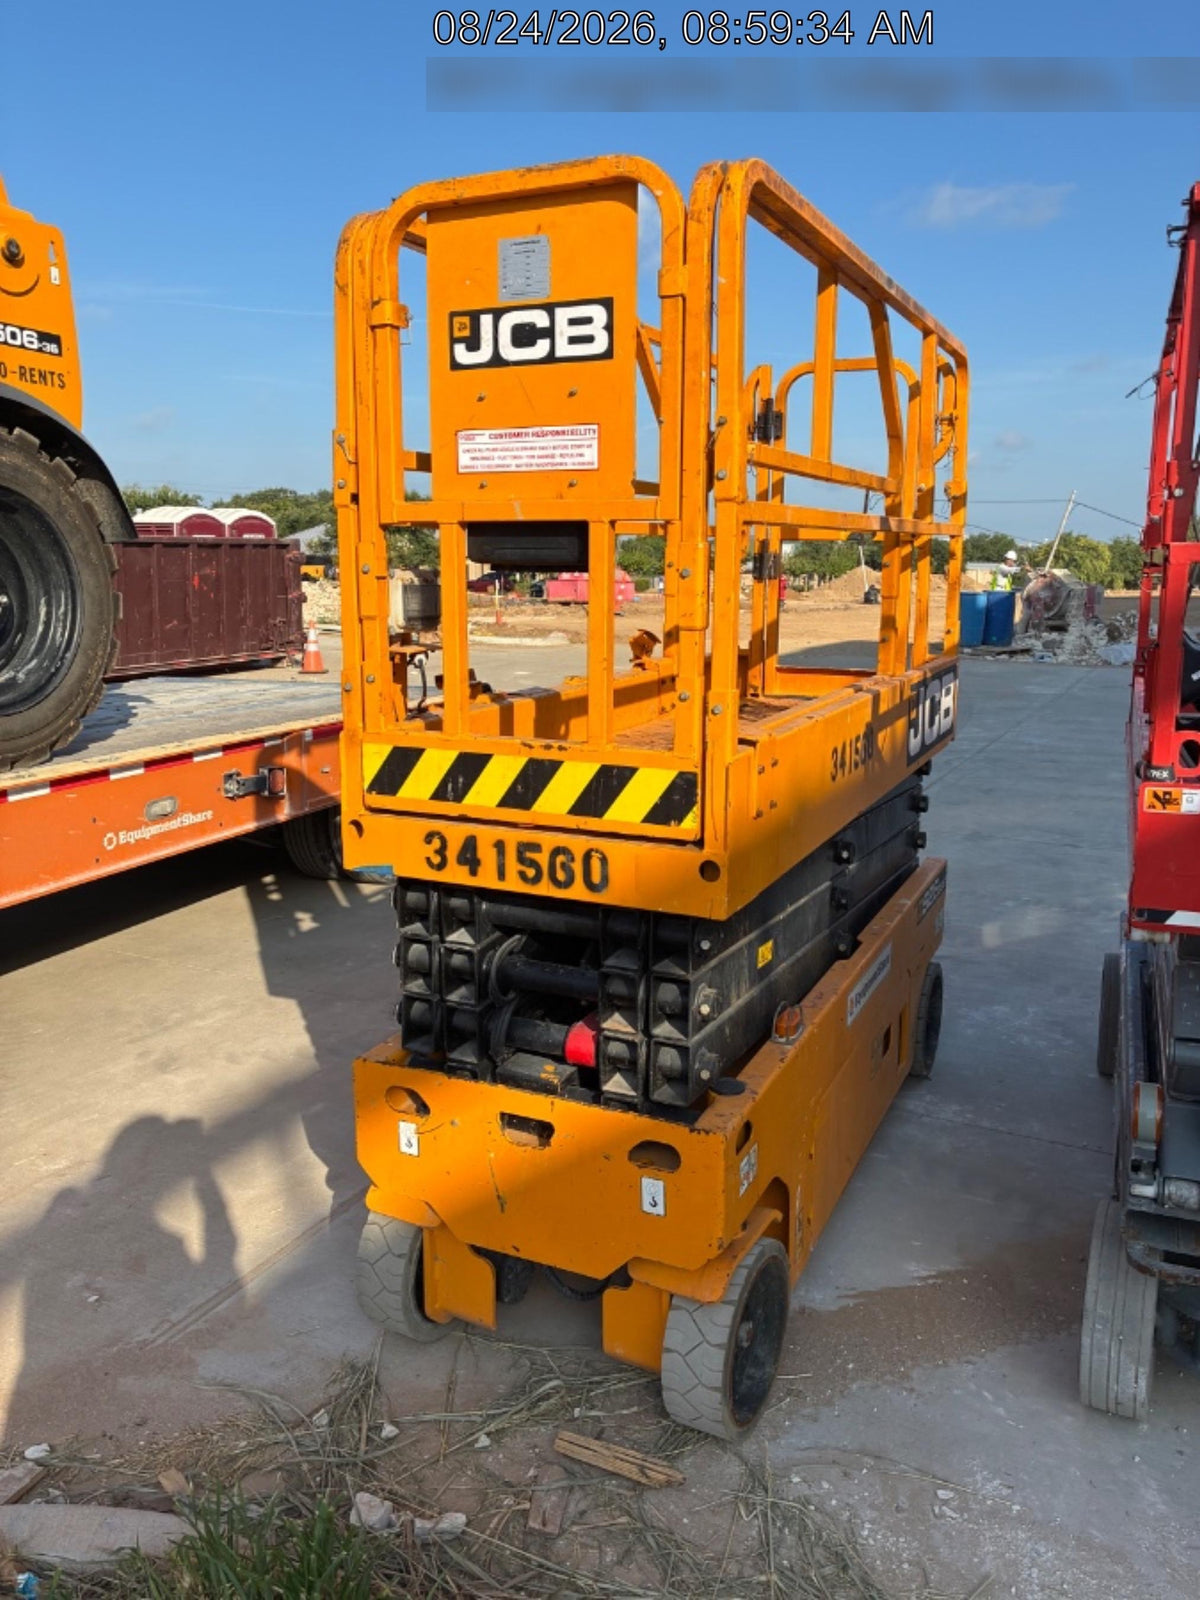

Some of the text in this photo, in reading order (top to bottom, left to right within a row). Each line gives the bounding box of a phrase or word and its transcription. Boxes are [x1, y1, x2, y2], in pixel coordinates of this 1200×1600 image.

[453, 304, 609, 365] JCB
[909, 672, 955, 756] JCB
[118, 810, 213, 845] EquipmentShare
[424, 830, 609, 893] 341560
